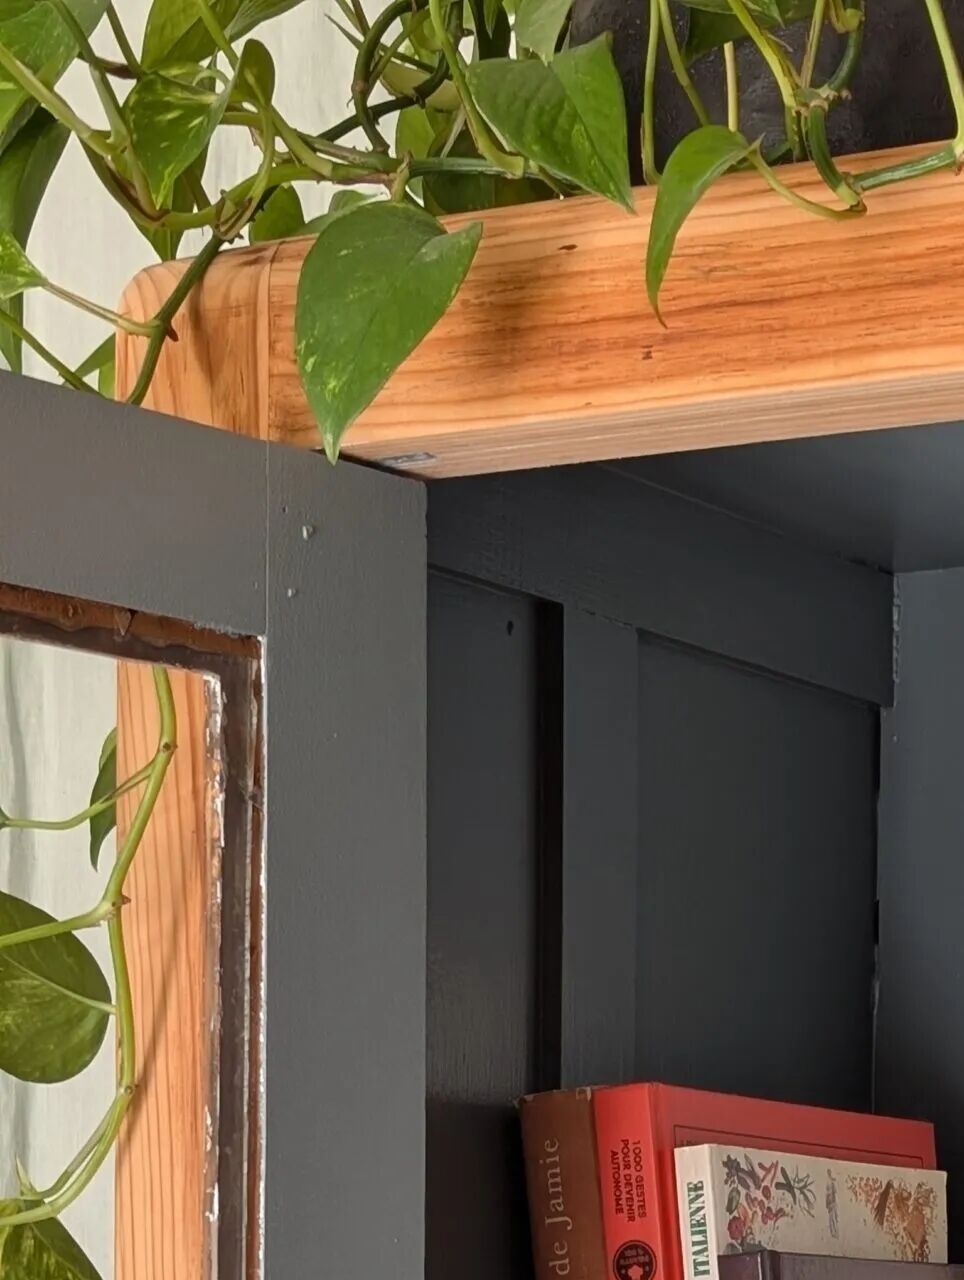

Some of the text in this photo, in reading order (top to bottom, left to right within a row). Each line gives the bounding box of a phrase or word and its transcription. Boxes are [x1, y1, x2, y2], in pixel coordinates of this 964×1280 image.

[539, 1139, 572, 1231] Jamie
[611, 1150, 624, 1214] AUTONOME
[620, 1139, 636, 1222] POUR DEVENIR
[632, 1140, 647, 1218] 1000 GESTES
[549, 1240, 570, 1275] de
[687, 1180, 711, 1280] ITALIENNE
